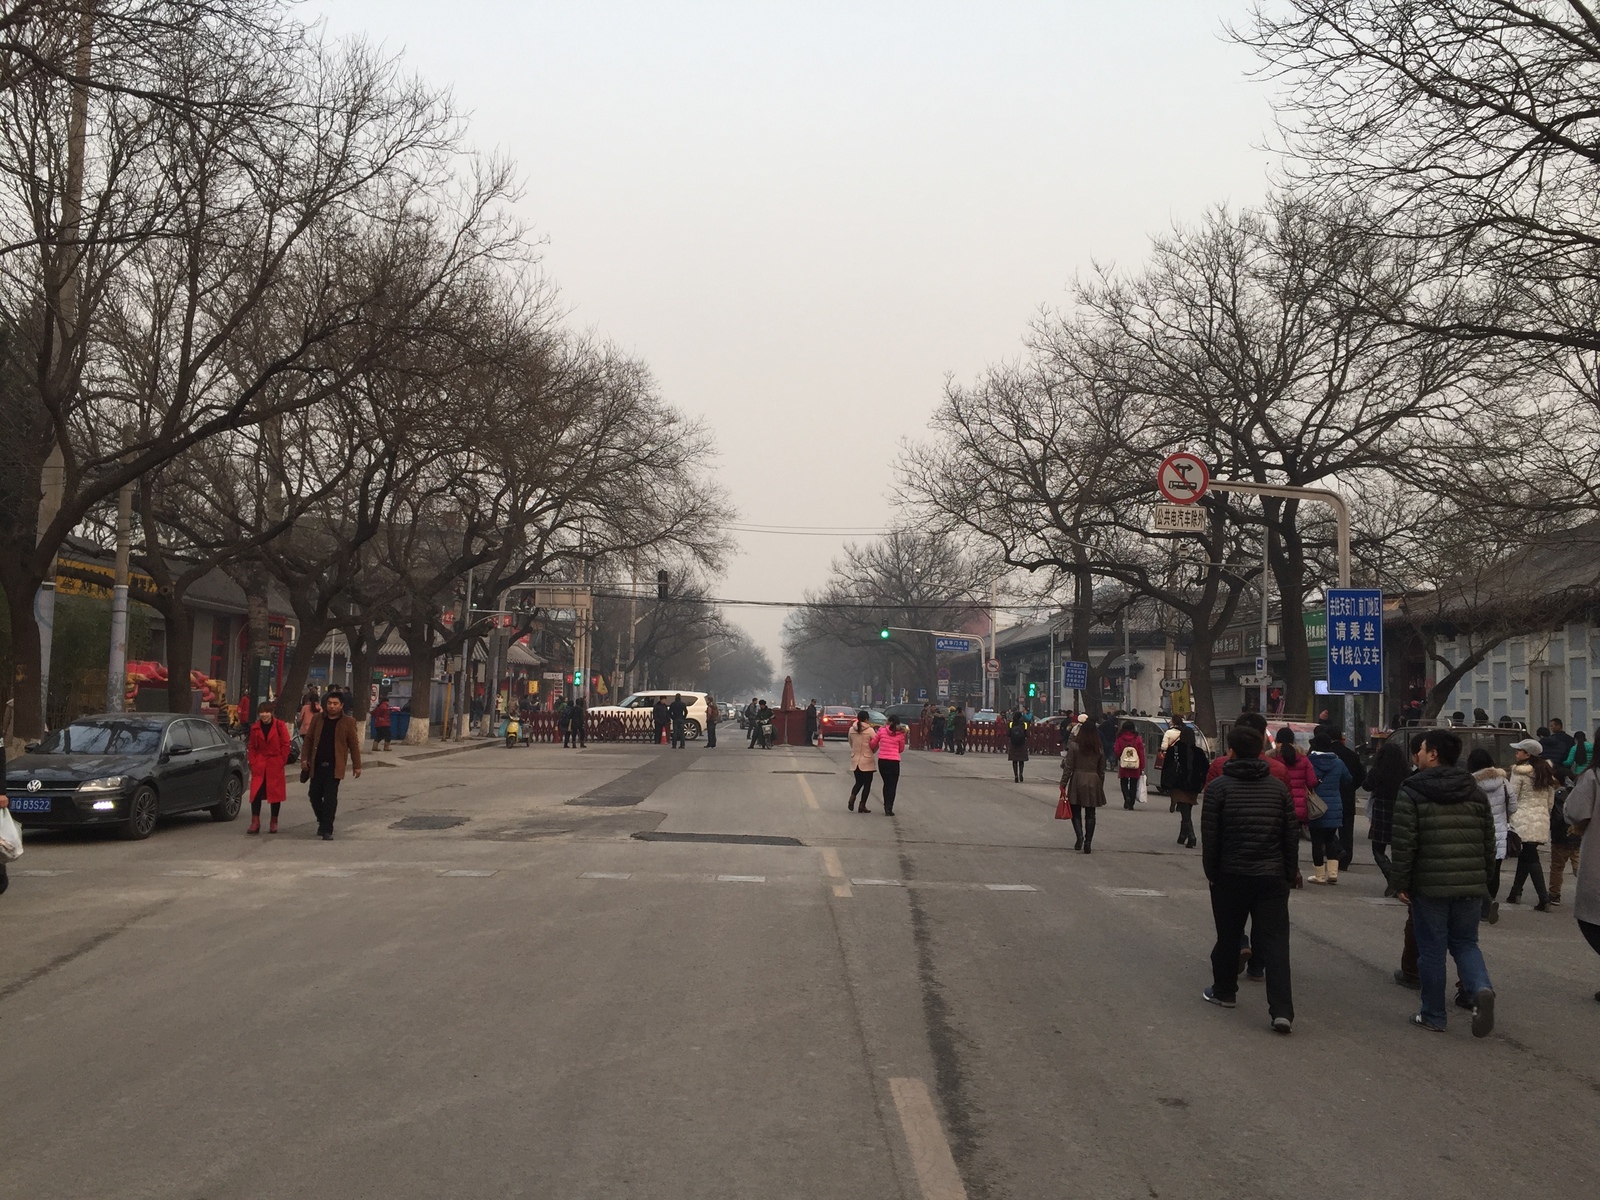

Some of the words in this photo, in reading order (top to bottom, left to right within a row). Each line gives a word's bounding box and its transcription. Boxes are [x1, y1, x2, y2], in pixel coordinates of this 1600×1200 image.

[1158, 508, 1204, 528] 公共电汽车除外
[1330, 597, 1380, 616] 去往天安门、前门地区
[1335, 621, 1375, 641] 请乘坐
[1330, 646, 1380, 665] 专1线公交车
